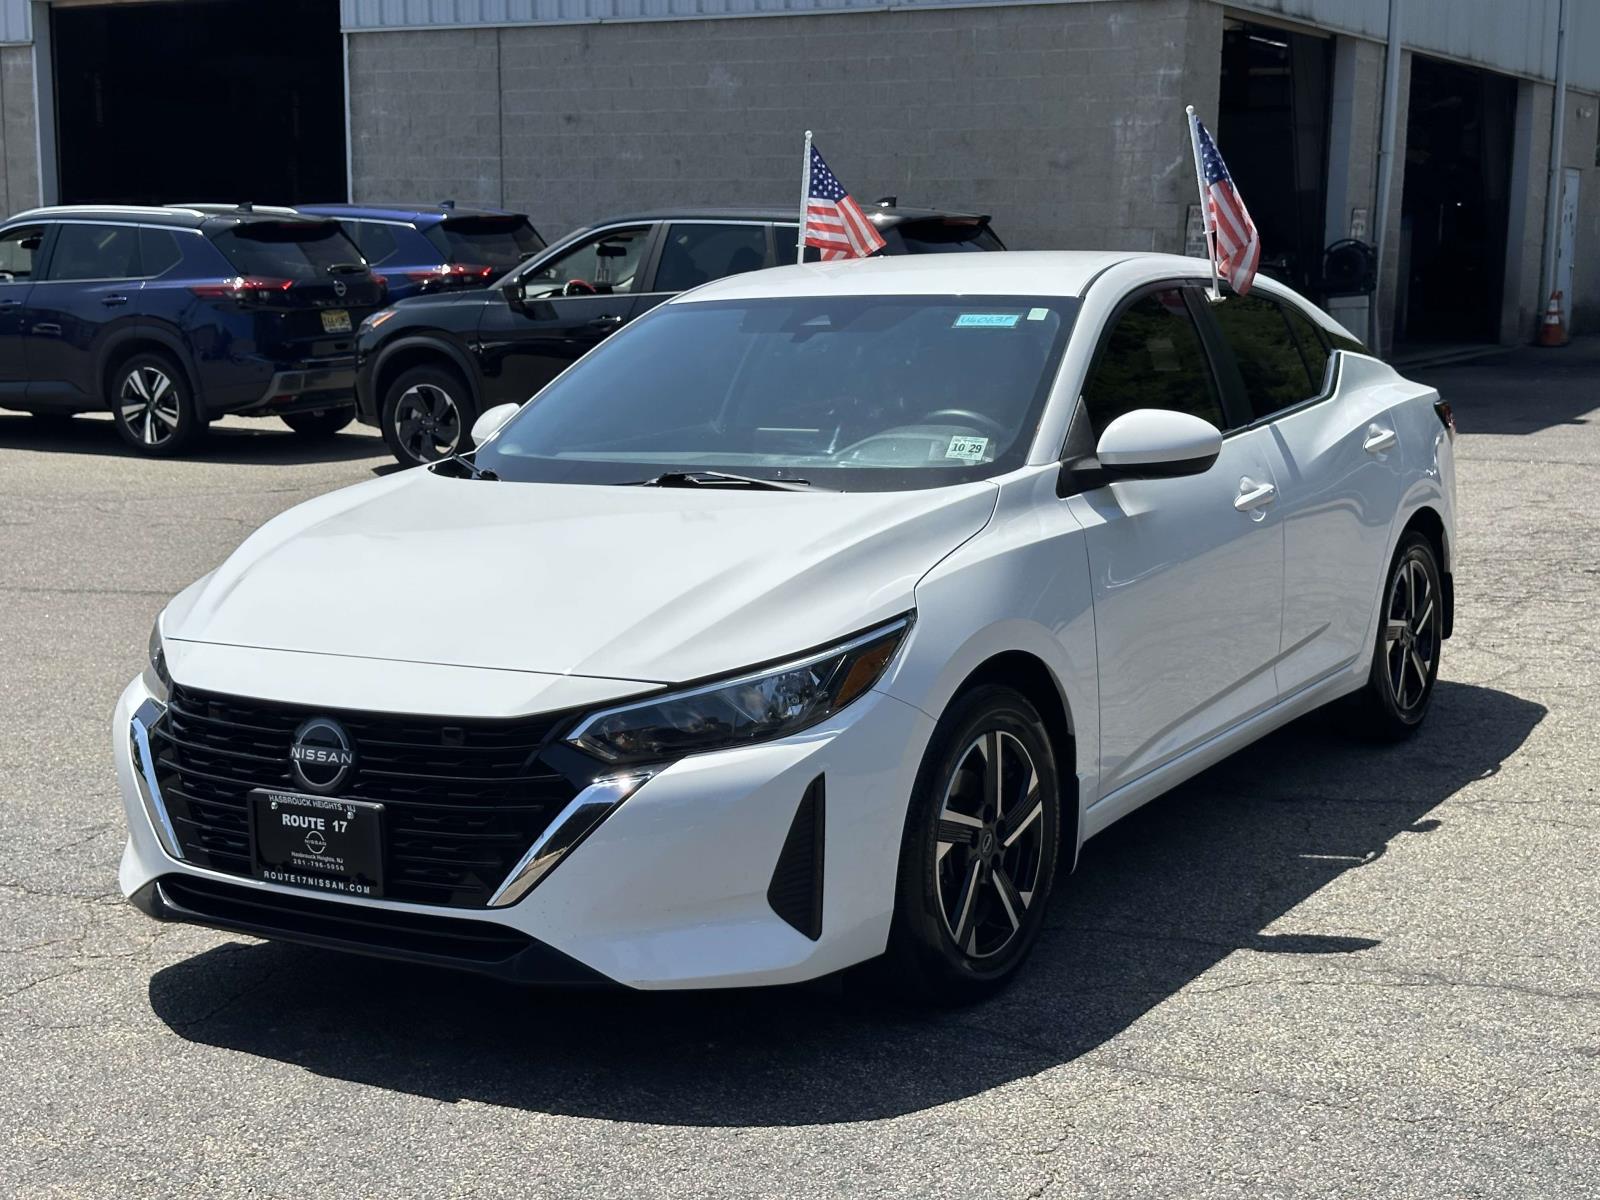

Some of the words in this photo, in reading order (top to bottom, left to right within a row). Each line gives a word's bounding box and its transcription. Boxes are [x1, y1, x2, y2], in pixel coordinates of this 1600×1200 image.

[952, 443, 966, 452] 10
[968, 444, 982, 454] 29
[291, 746, 353, 764] NISSAN
[269, 795, 312, 806] HASBROUCK
[281, 813, 325, 830] ROUTE
[332, 820, 348, 833] 17
[263, 870, 370, 894] ROUTE17NISSAN.COM
